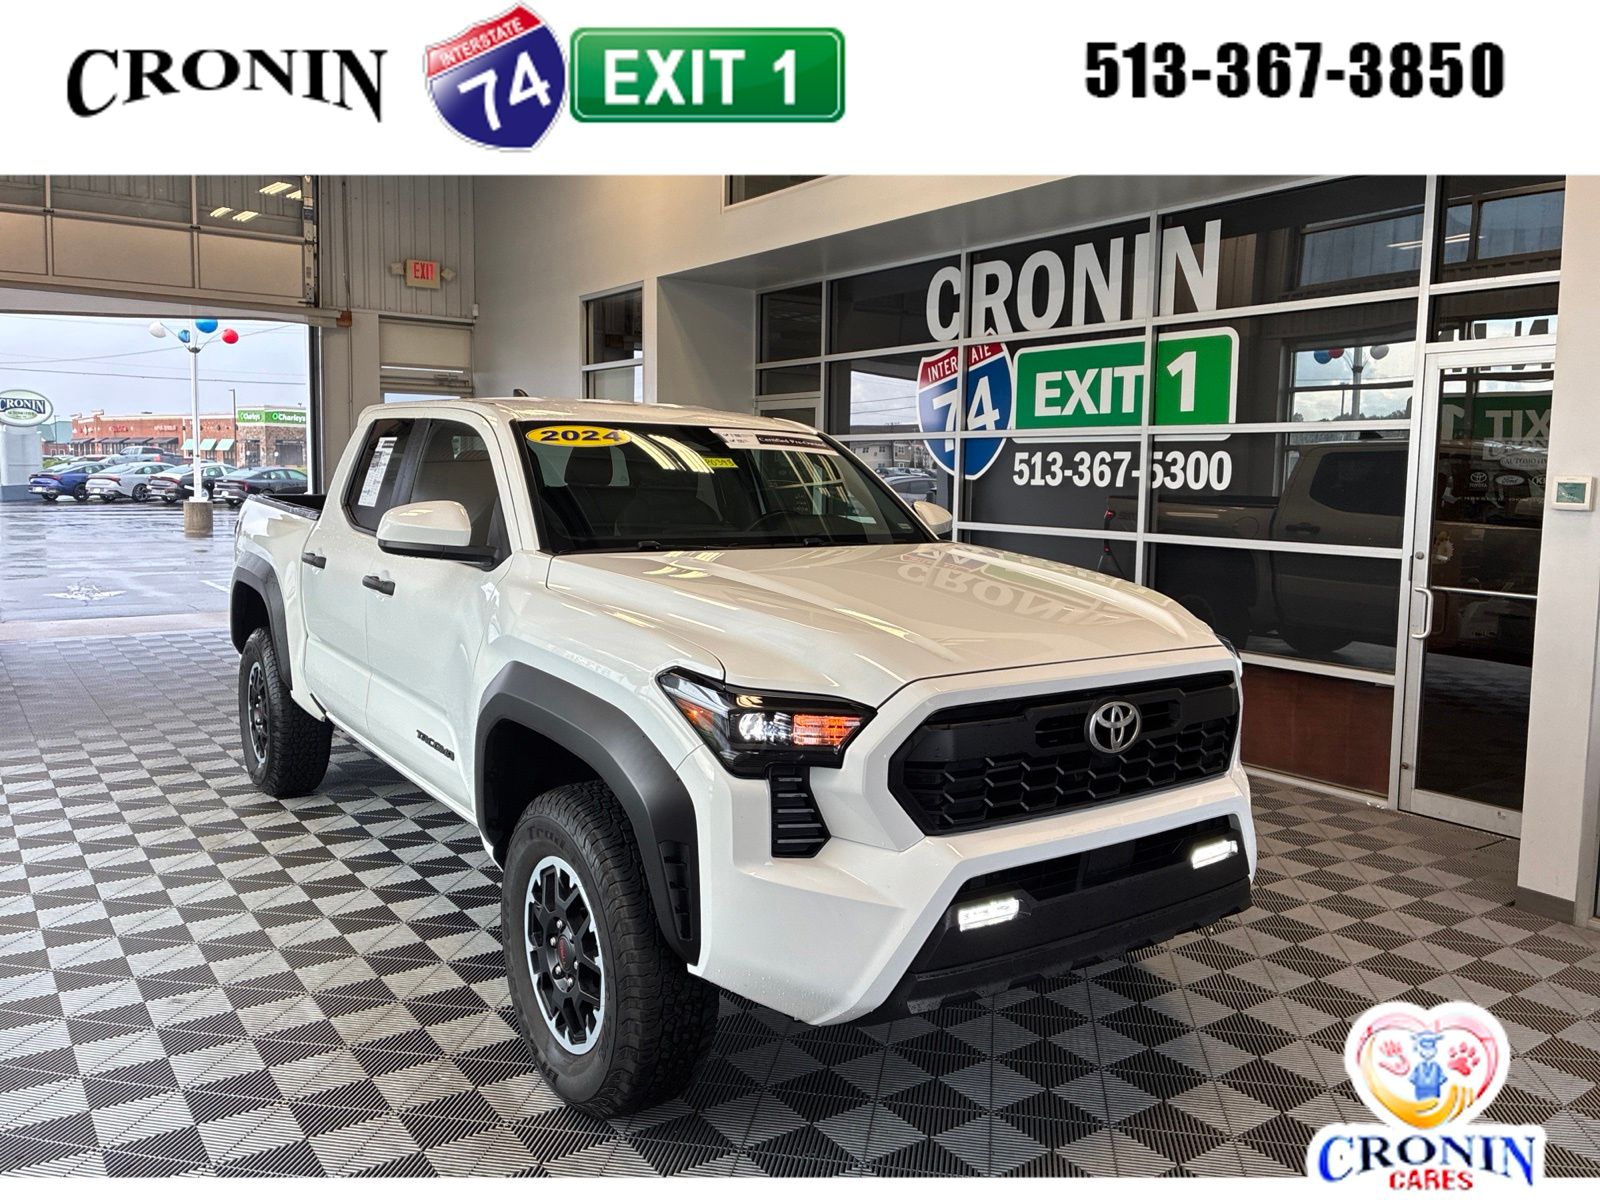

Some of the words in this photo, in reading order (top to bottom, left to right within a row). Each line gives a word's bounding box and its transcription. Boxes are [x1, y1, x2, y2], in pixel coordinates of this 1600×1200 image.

[413, 261, 434, 280] EXIT
[926, 219, 1222, 342] CRONIN
[927, 344, 992, 382] INTERATE
[1034, 364, 1145, 417] EXIT
[1166, 350, 1197, 412] 1
[0, 399, 45, 413] CRONIN
[932, 375, 1000, 453] 74
[541, 429, 621, 442] 2024
[1013, 450, 1233, 490] 513-367-5300
